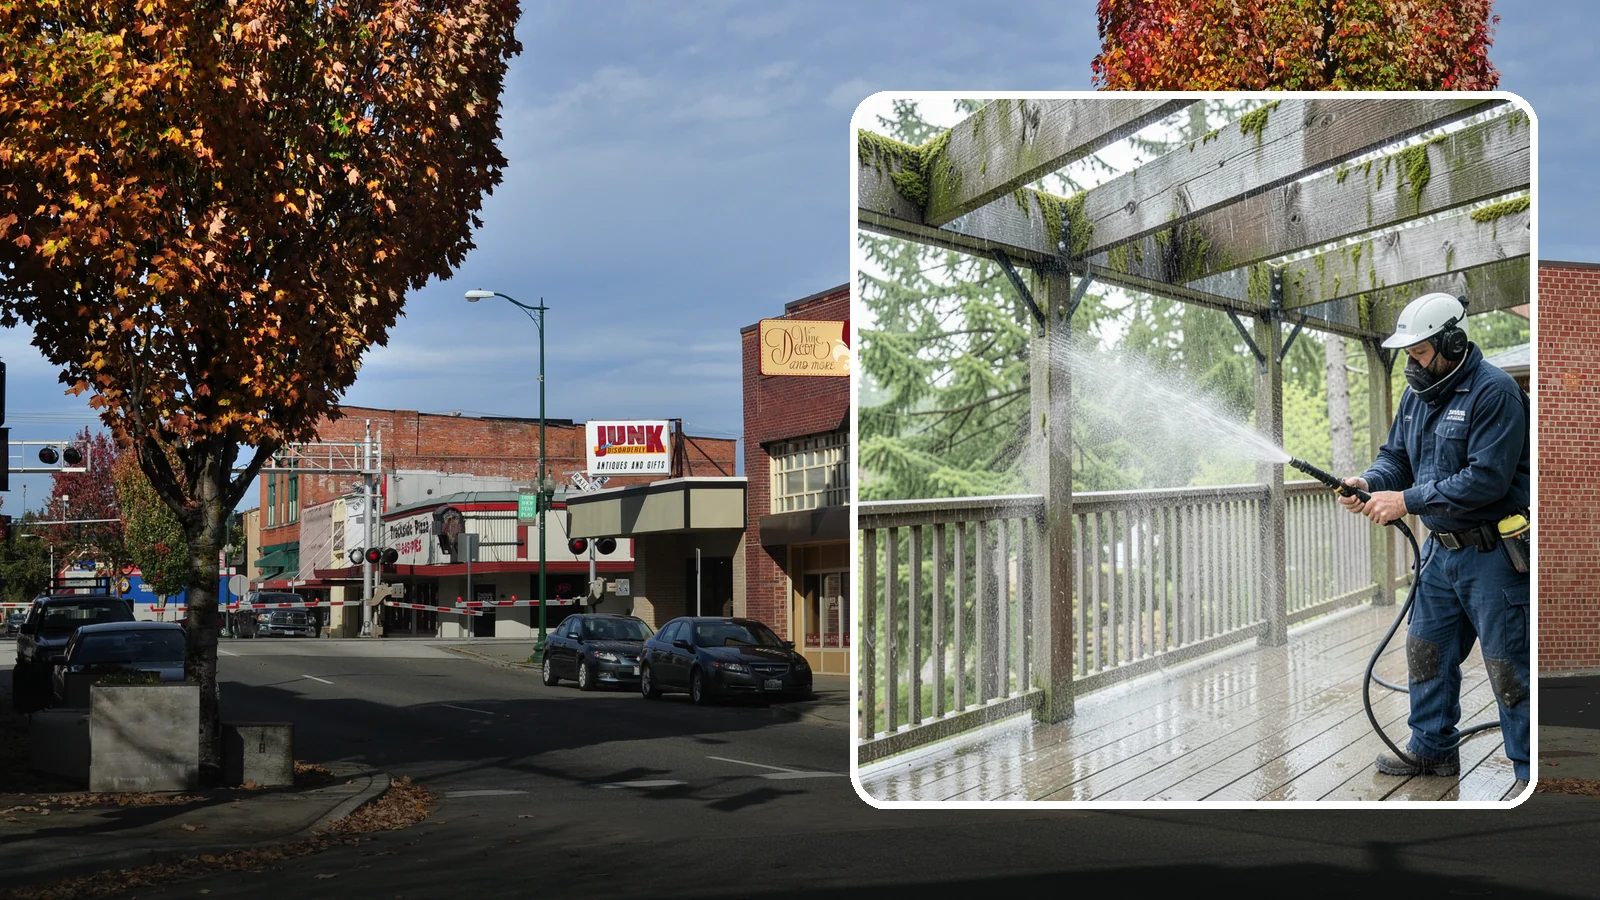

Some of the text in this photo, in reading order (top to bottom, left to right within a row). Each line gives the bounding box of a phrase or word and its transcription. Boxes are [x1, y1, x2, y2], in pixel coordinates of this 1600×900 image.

[596, 425, 665, 457] JUNK
[607, 446, 646, 454] DISORDERLY
[597, 460, 665, 470] ANTIQUES AND GIFTS
[390, 519, 429, 540] Trackside Pizza
